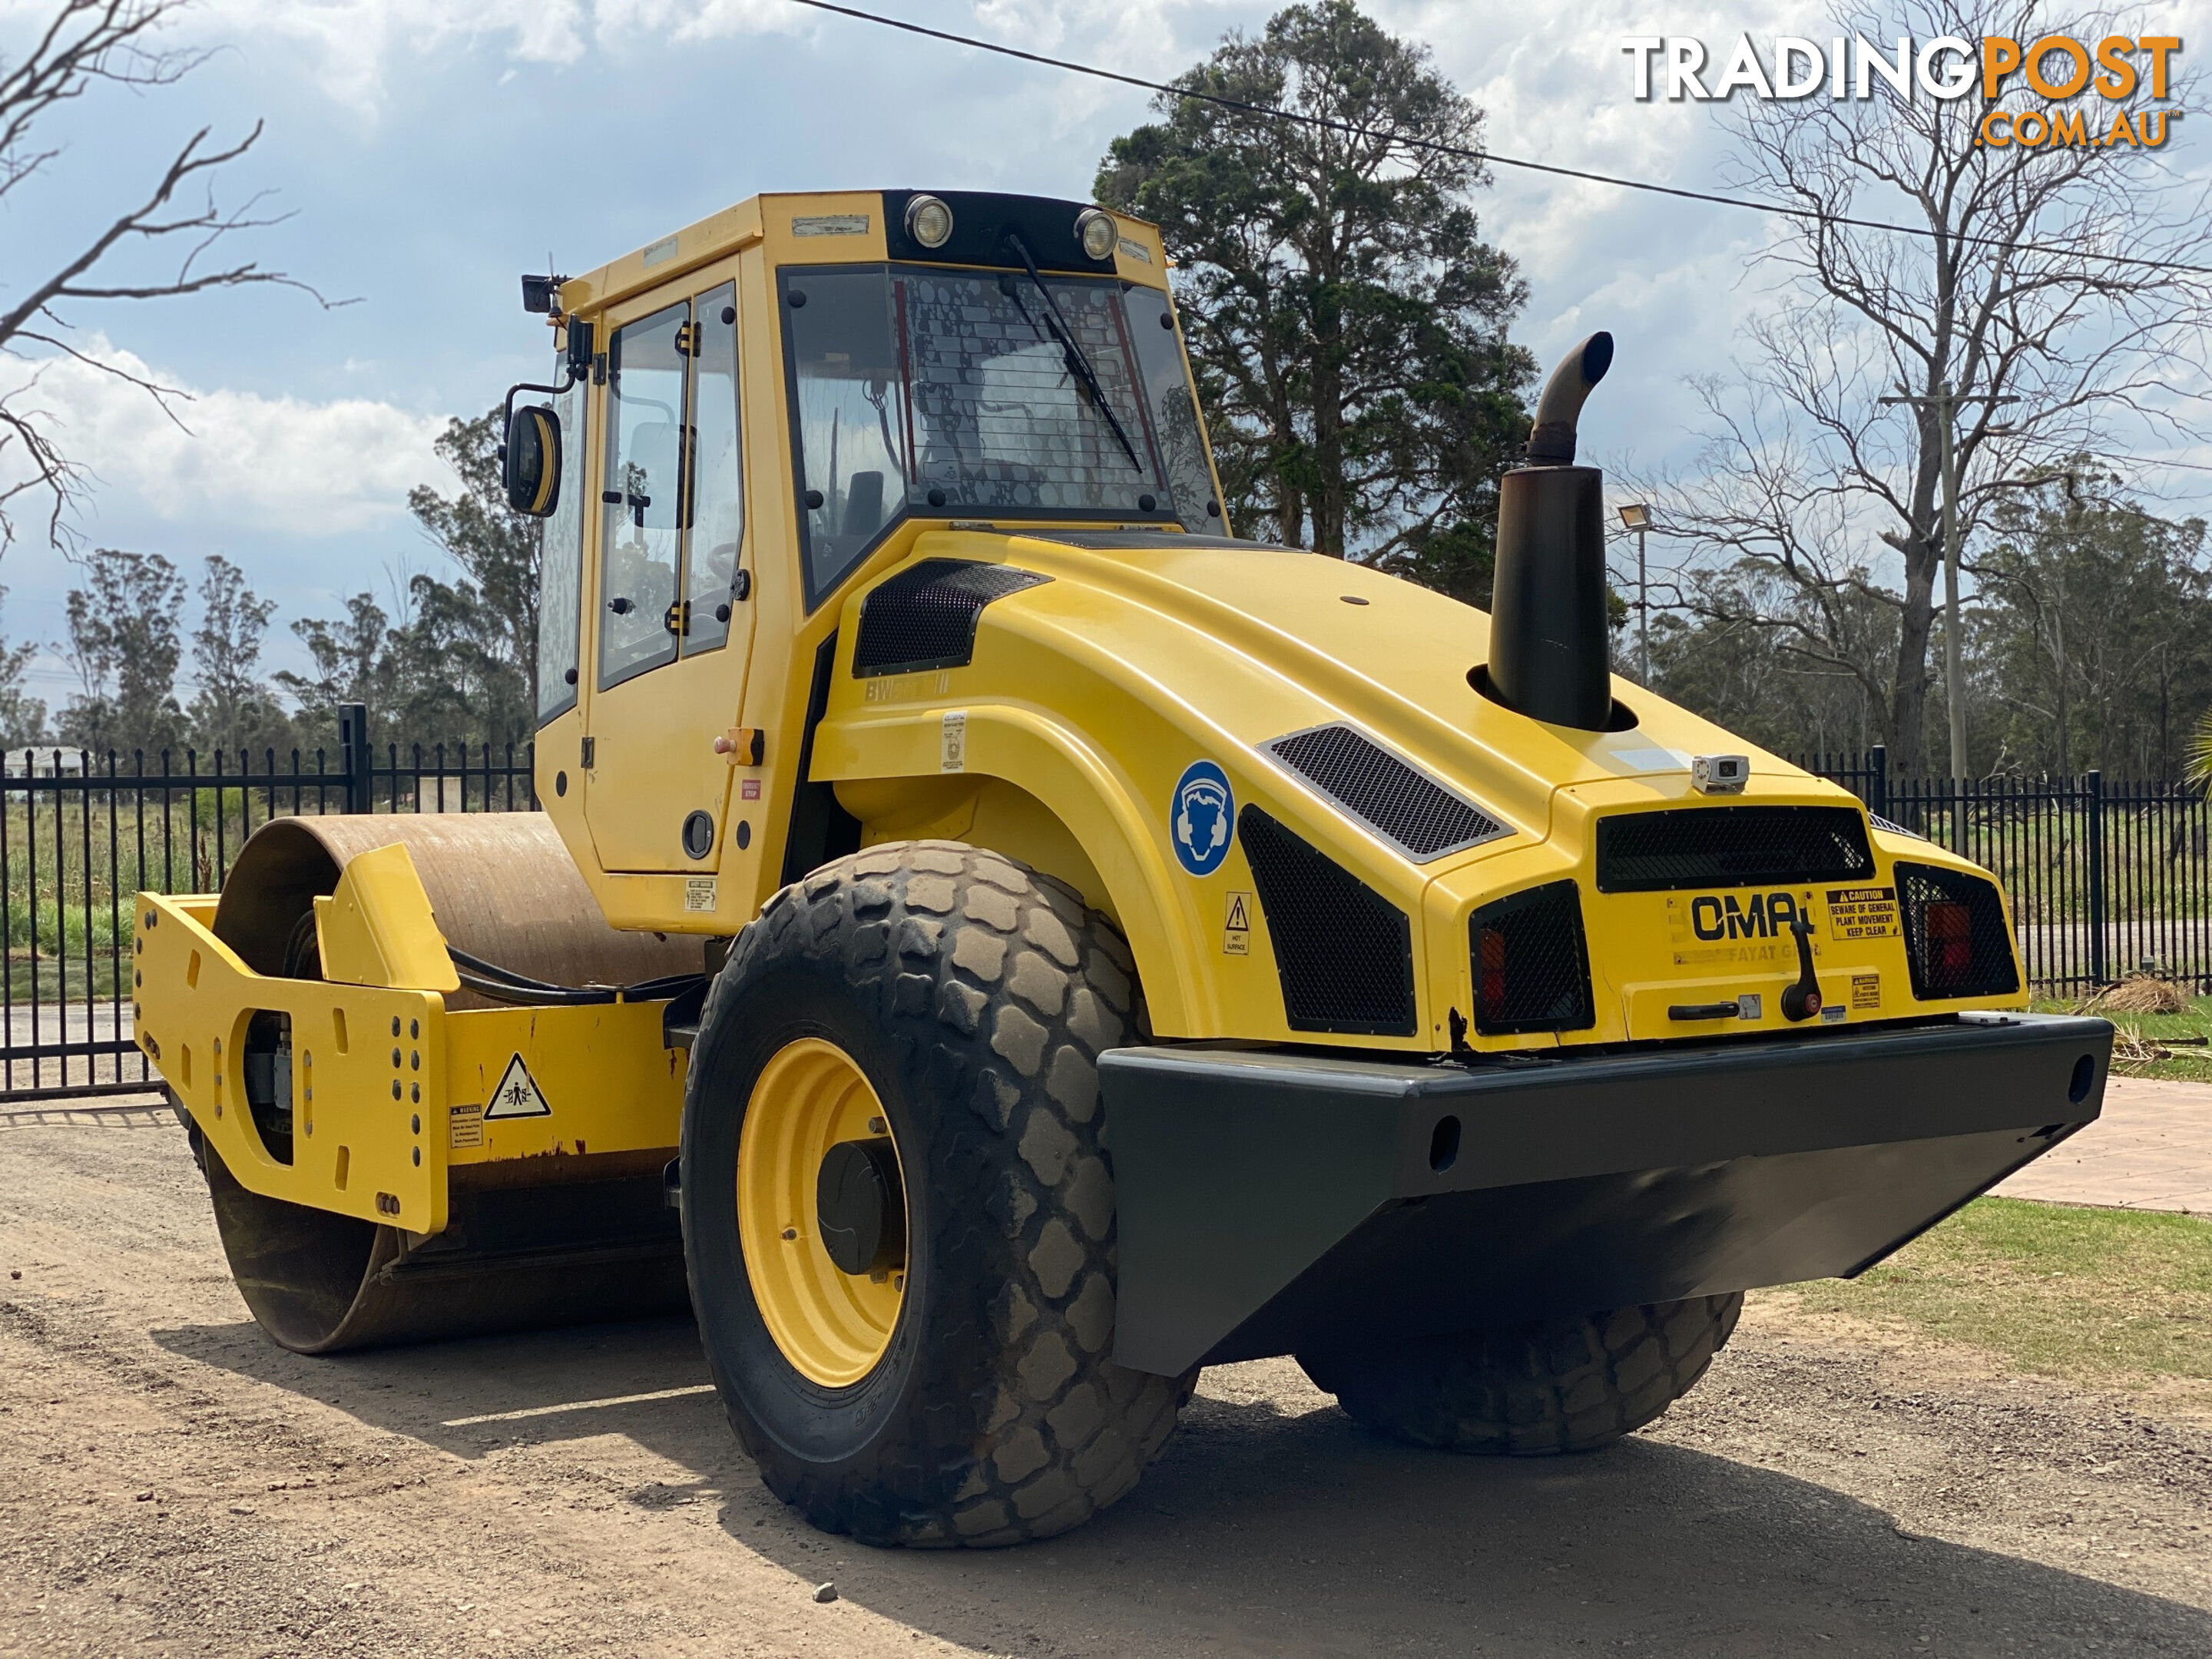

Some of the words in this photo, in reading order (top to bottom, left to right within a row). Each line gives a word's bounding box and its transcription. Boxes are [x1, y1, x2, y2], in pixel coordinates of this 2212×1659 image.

[1848, 889, 1884, 901] CAUTION
[1830, 905, 1856, 916] BEWARE
[1858, 903, 1866, 913] OF
[1867, 902, 1895, 913] GENERAL
[1836, 916, 1856, 926] PLANT
[1857, 914, 1893, 925] MOVEMENT
[1846, 927, 1863, 937] KEEP
[1865, 926, 1886, 935] CLEAR
[459, 1105, 480, 1114] WARNING
